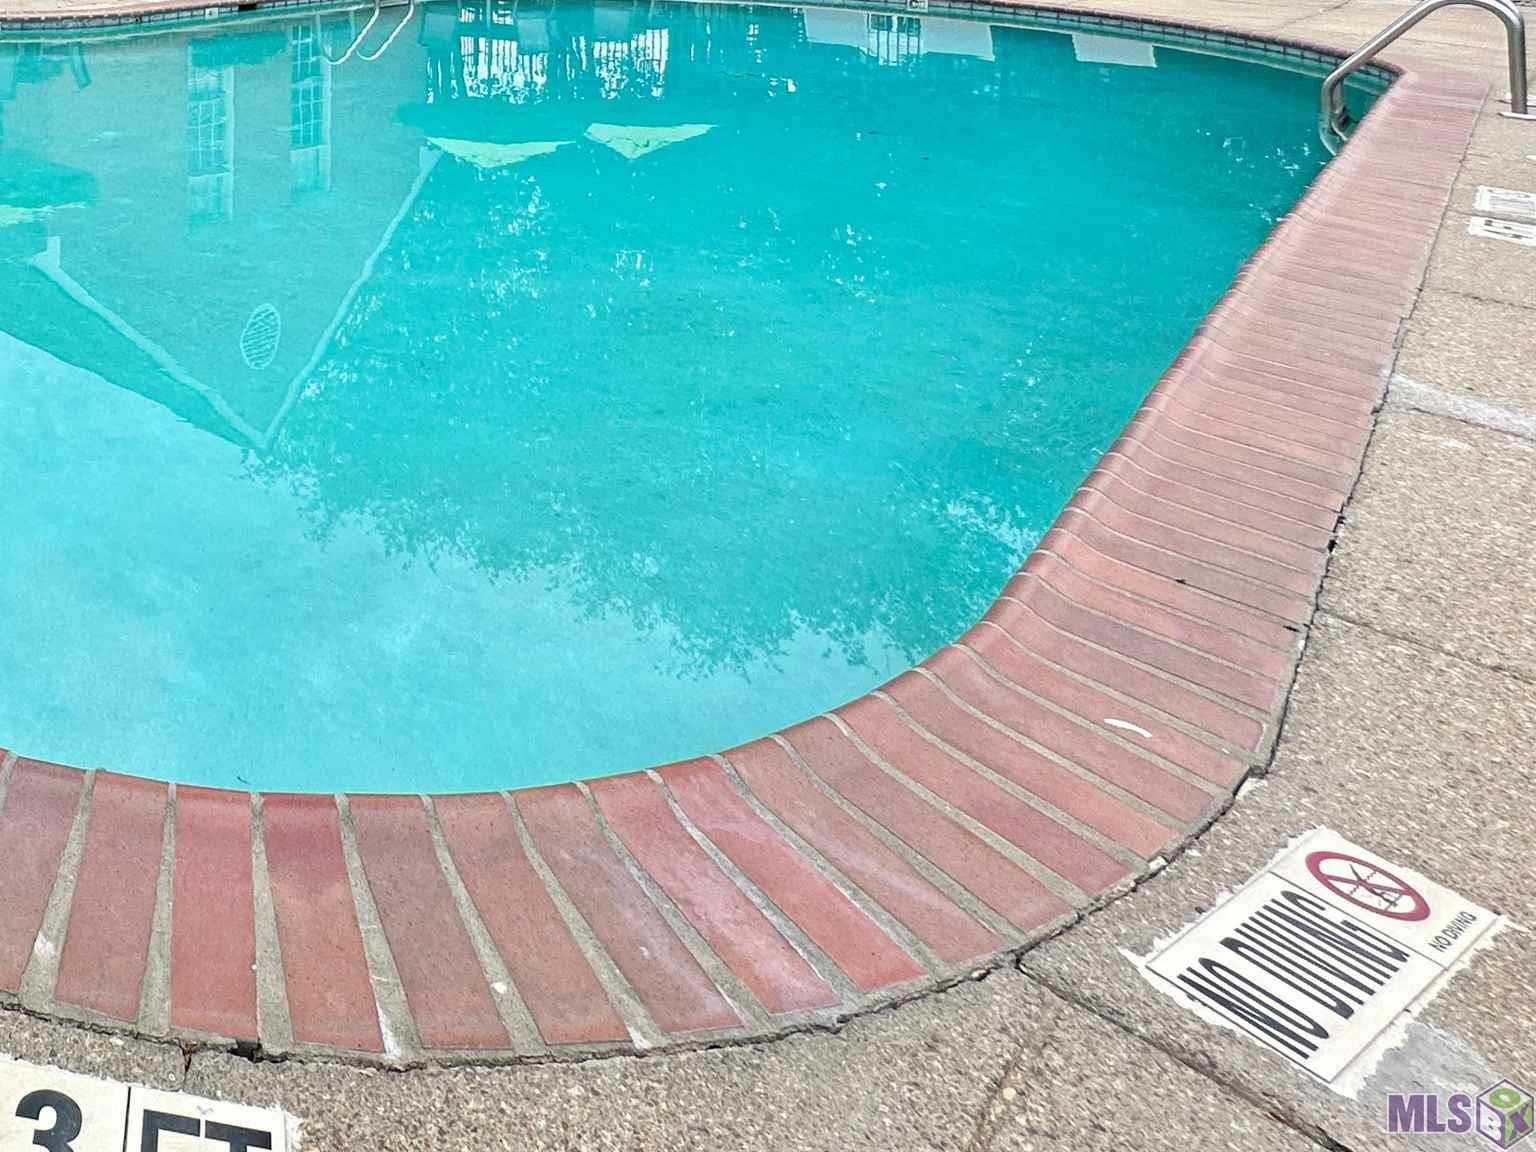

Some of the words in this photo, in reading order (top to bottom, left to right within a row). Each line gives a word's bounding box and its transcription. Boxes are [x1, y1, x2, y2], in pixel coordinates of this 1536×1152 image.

[1218, 890, 1411, 1020] DIVING
[1427, 935, 1452, 953] NO
[1176, 955, 1330, 1060] NO
